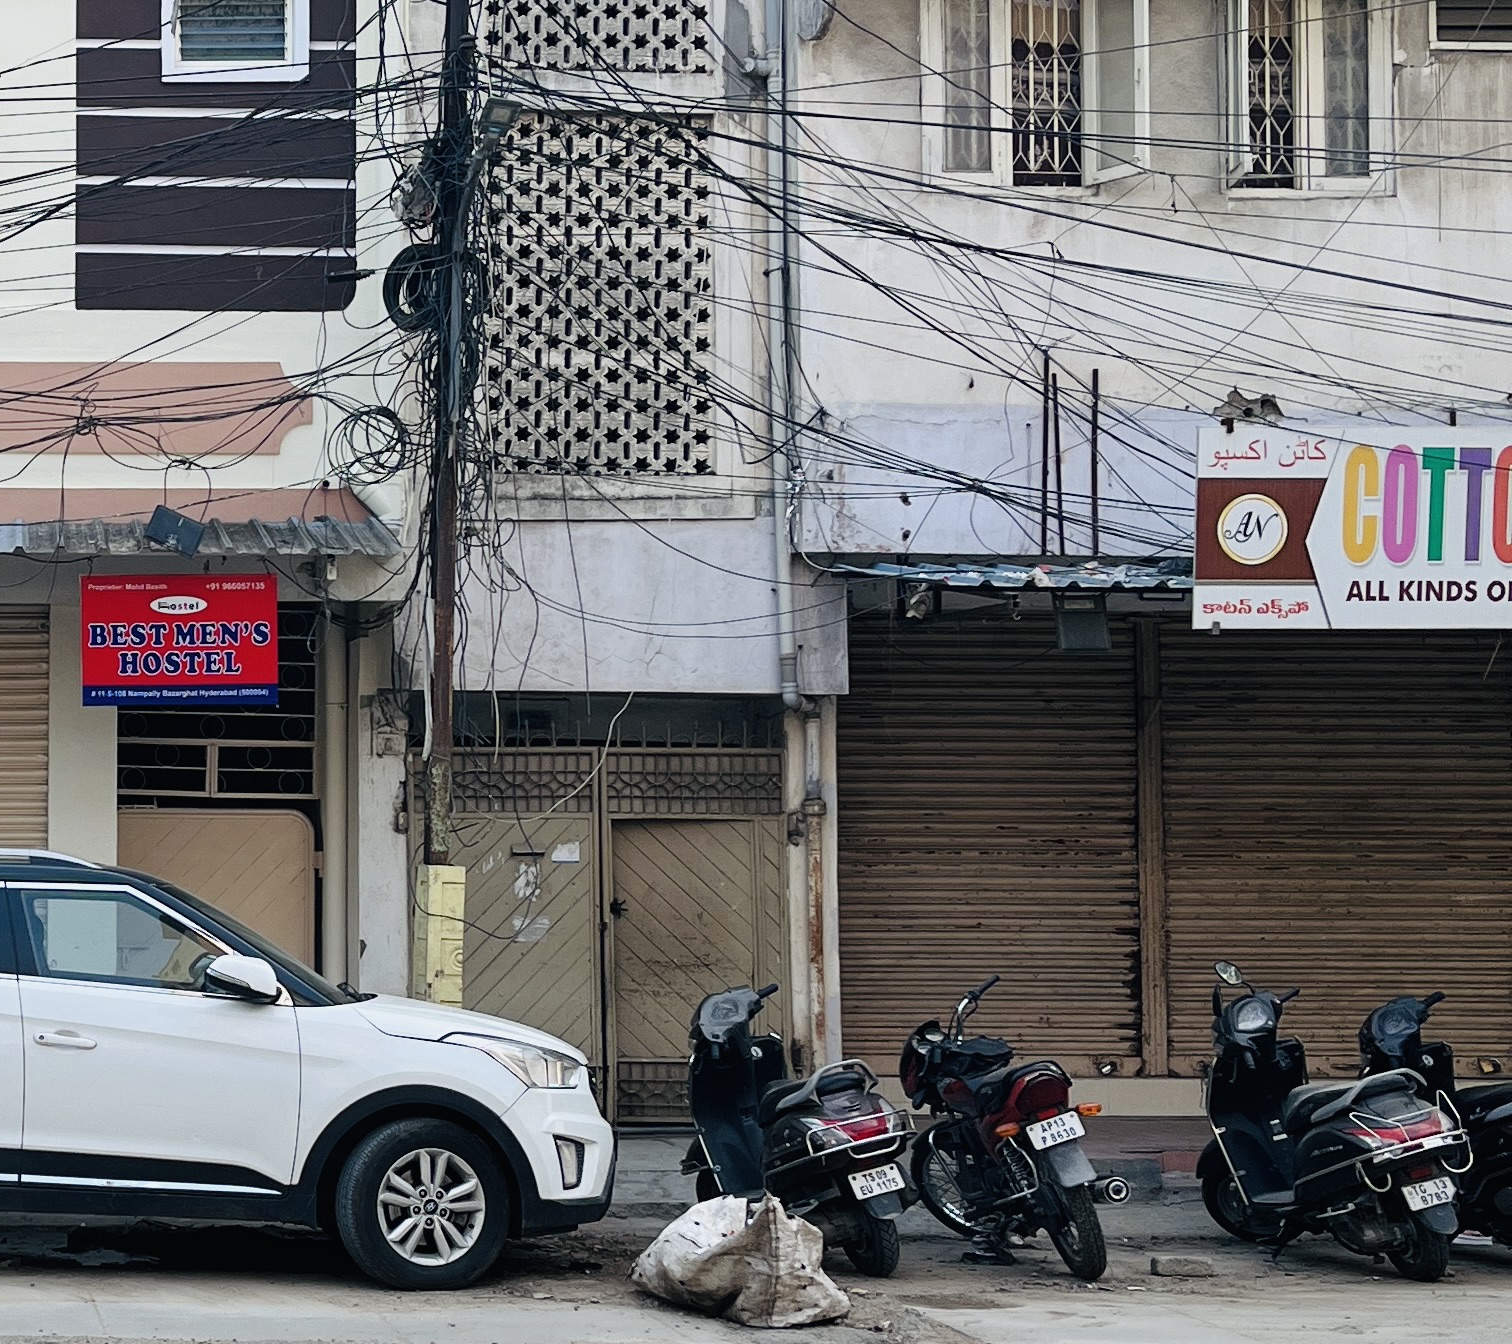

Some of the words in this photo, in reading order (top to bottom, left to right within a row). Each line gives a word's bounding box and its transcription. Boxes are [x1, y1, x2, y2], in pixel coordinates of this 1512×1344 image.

[1346, 580, 1390, 603] ALL
[1398, 580, 1478, 603] KINDS
[1486, 580, 1512, 603] O
[87, 622, 168, 648] BEST
[173, 620, 271, 647] MEN'S
[116, 651, 242, 677] HOSTEL
[862, 1172, 876, 1184] TS
[860, 1184, 874, 1196] EU
